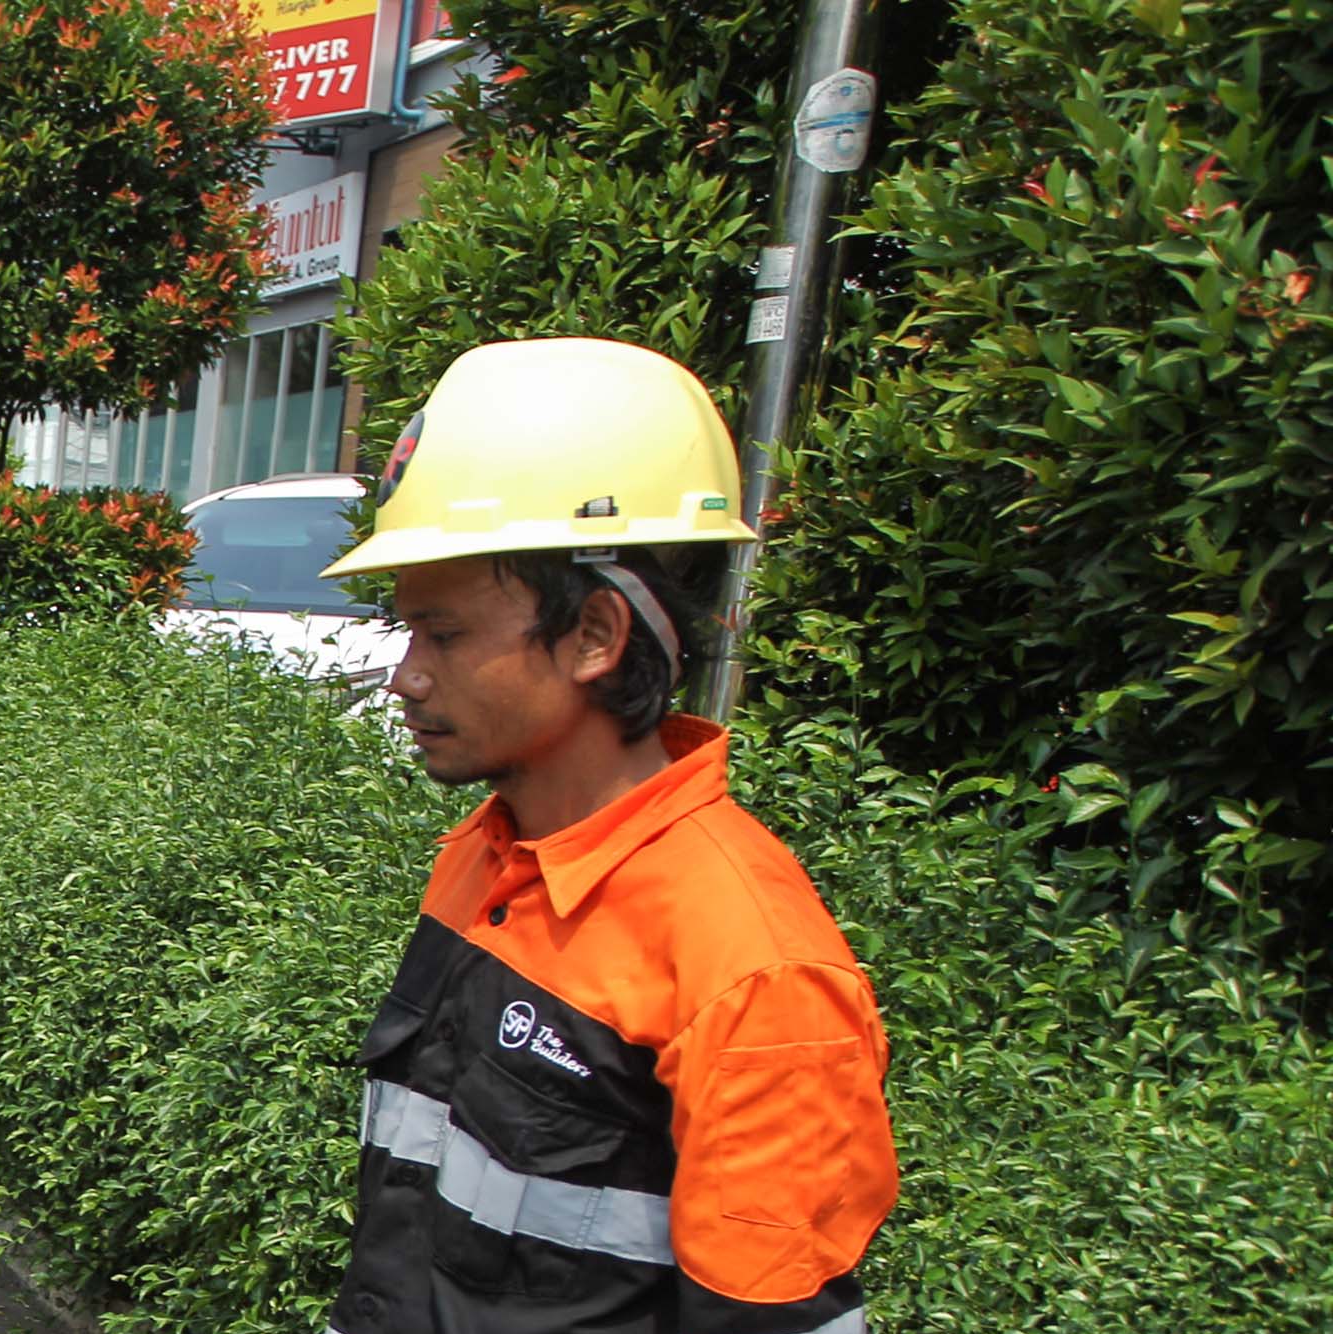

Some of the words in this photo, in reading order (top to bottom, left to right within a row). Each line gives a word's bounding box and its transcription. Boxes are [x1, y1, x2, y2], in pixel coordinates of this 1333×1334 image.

[296, 64, 358, 101] 777
[536, 1024, 564, 1049] The
[530, 1038, 592, 1077] Builders
